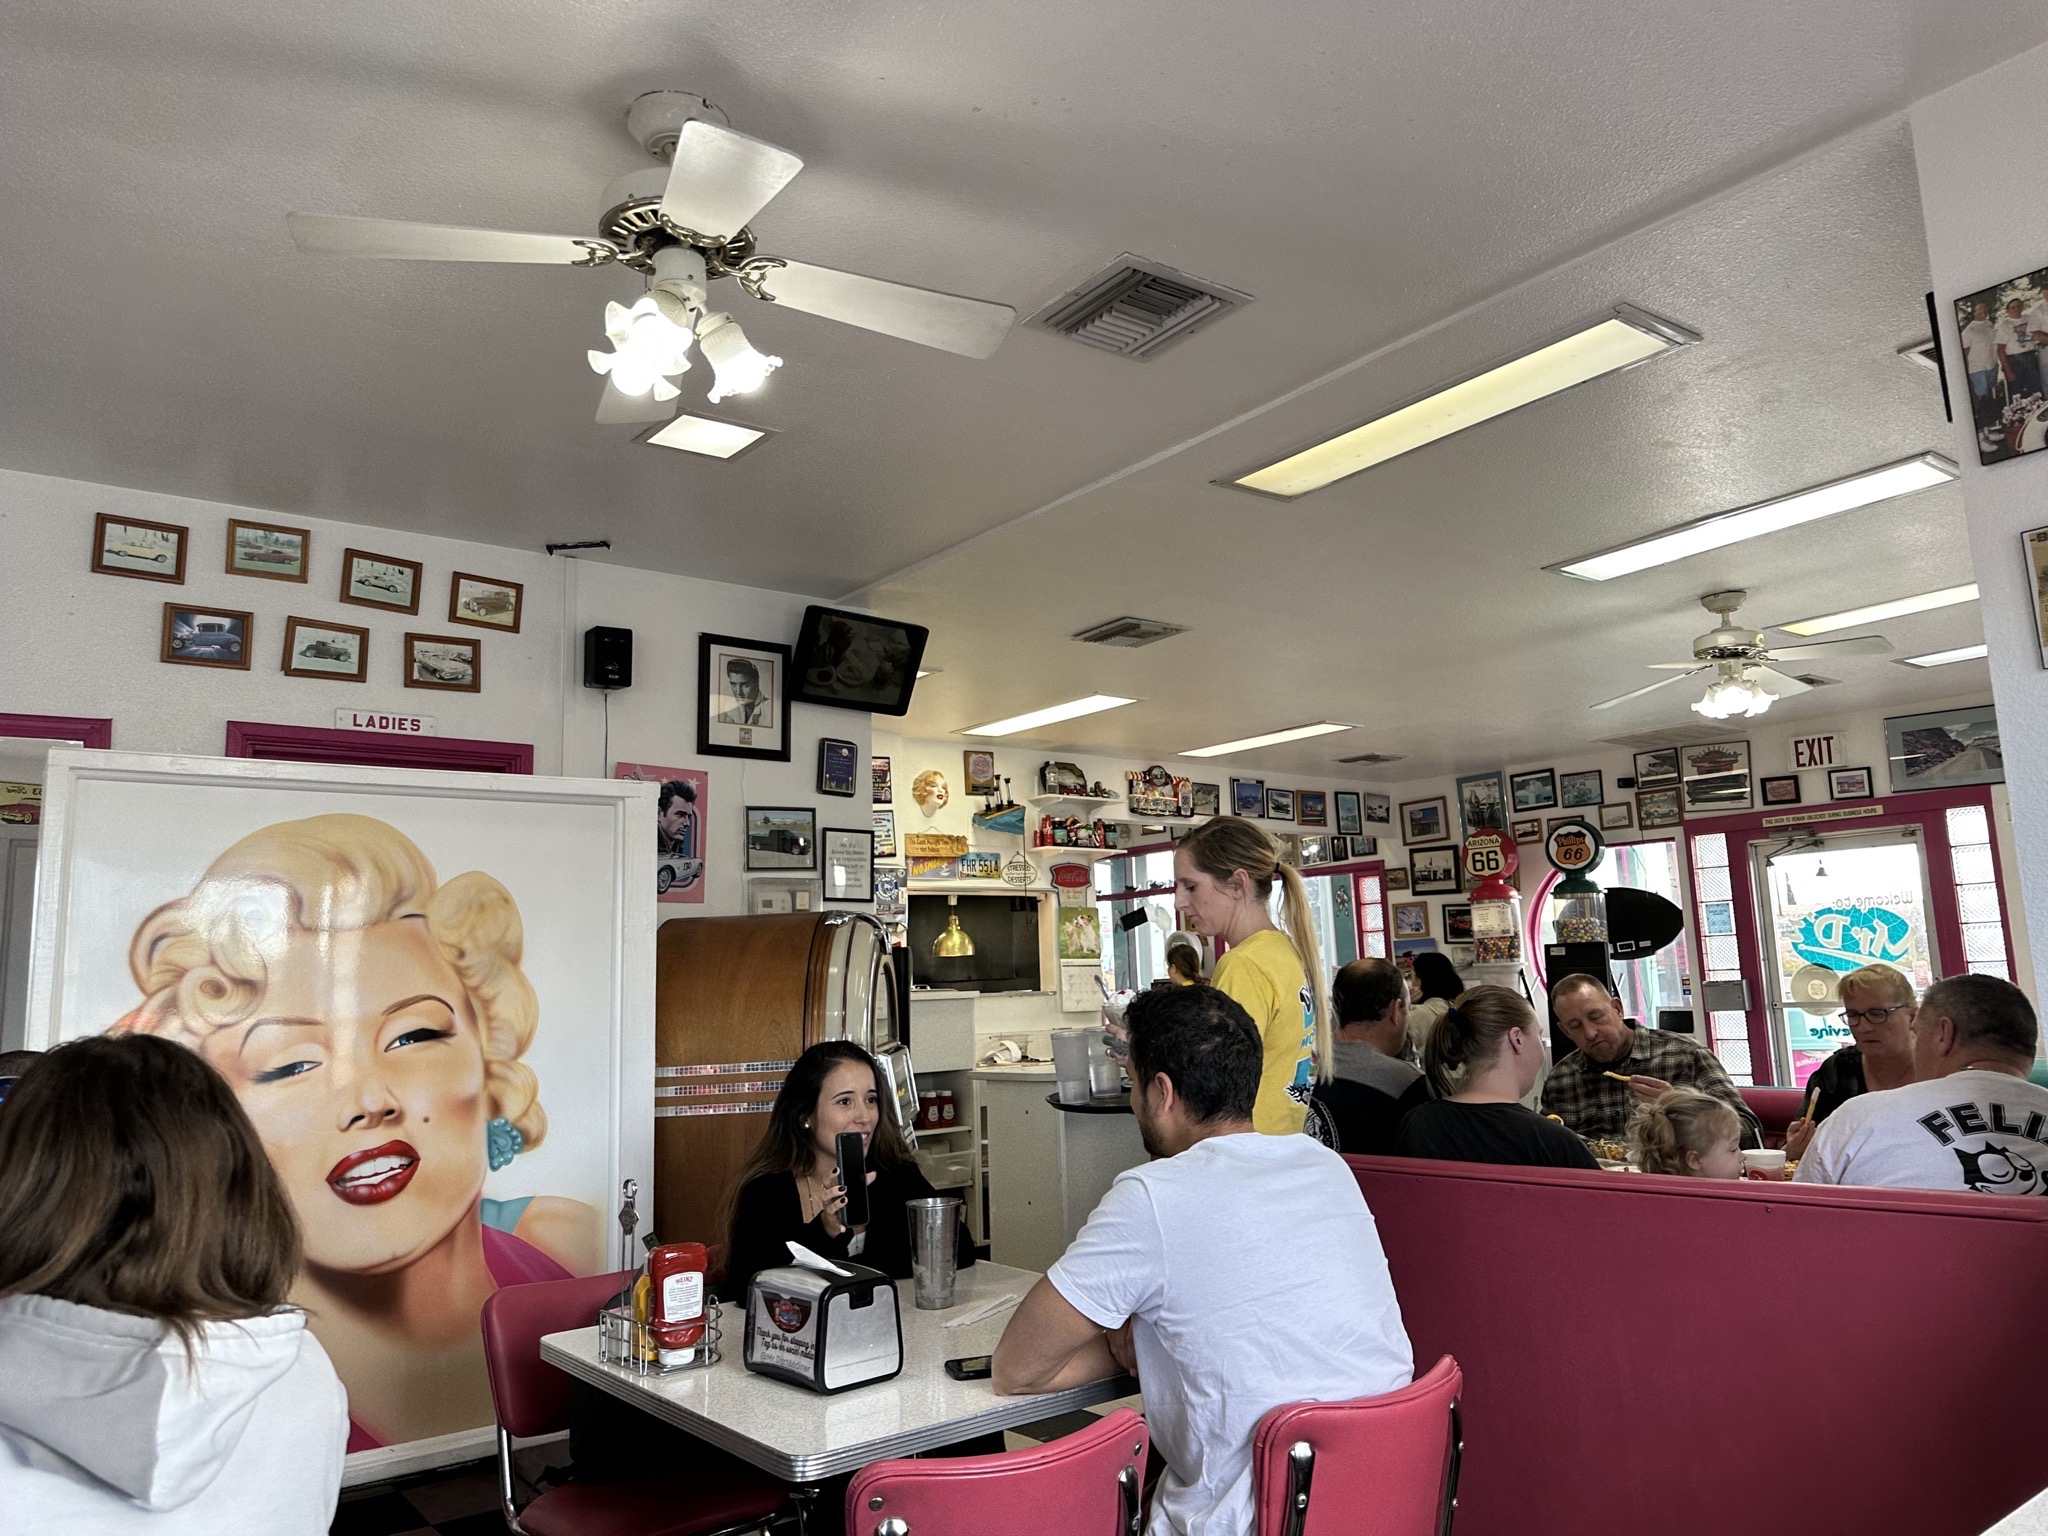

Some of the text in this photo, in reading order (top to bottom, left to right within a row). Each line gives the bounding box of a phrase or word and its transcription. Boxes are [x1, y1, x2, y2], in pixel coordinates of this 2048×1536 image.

[352, 713, 421, 732] LADIES
[1794, 736, 1834, 768] EXIT
[1806, 813, 1827, 821] UNLOCKED
[1843, 809, 1863, 817] BUSINESS
[1863, 807, 1878, 815] HOURS
[1467, 837, 1500, 847] ARIZONA
[1556, 835, 1585, 847] Phillips
[1563, 847, 1583, 861] 66
[961, 858, 999, 875] FHR 5514
[1006, 863, 1032, 872] STRESSED
[1471, 850, 1500, 873] 66
[912, 864, 924, 877] NO
[1007, 875, 1032, 884] DESSERTS
[1916, 1102, 2048, 1147] FELI
[675, 1276, 694, 1285] HEINZ
[756, 1326, 771, 1339] Thank
[771, 1333, 781, 1342] you
[780, 1332, 790, 1344] for
[790, 1336, 810, 1351] stopping
[771, 1342, 778, 1350] us
[786, 1345, 800, 1357] social
[800, 1349, 815, 1360] media
